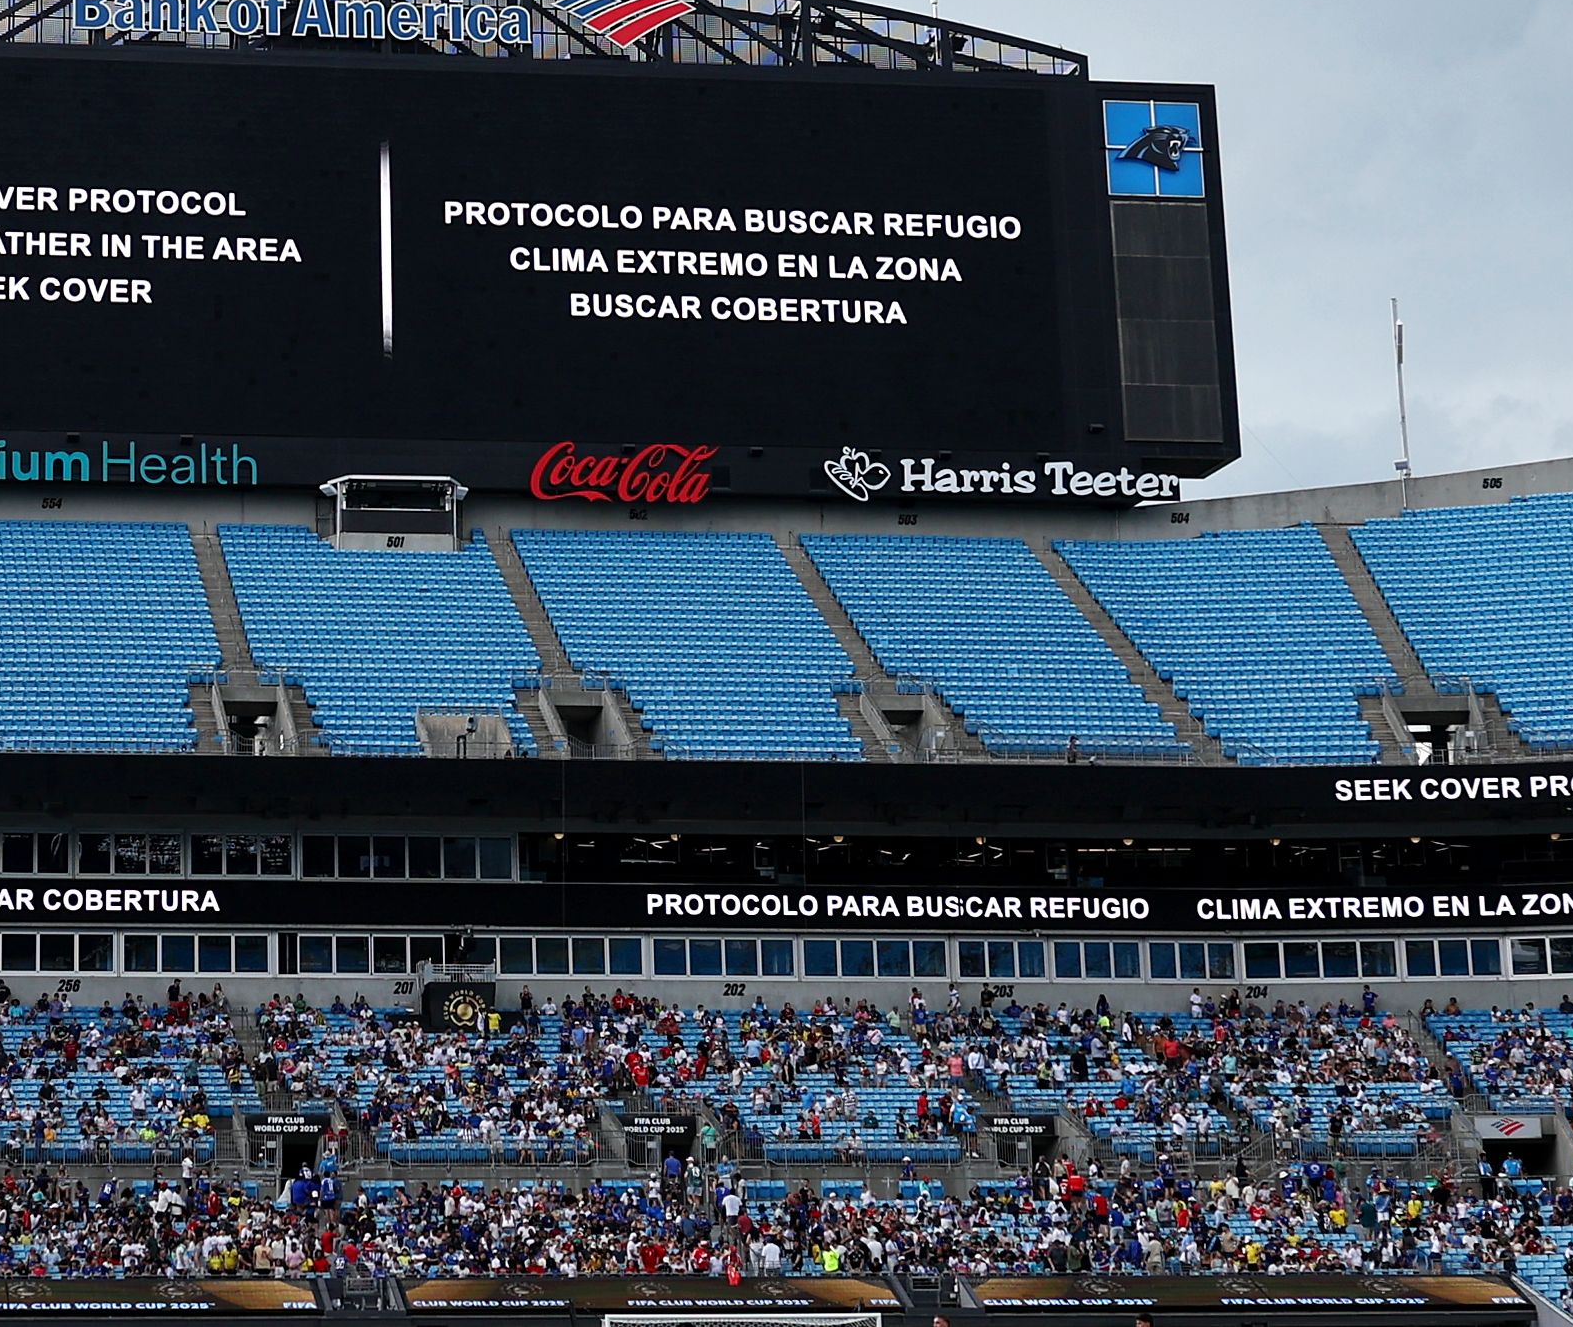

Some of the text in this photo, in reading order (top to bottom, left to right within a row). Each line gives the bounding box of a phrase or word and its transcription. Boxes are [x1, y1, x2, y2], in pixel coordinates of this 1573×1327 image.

[68, 187, 247, 216] PROTOCOL
[444, 200, 1022, 240] PROTOCOLO PARA BUSCAR REFUGIO
[101, 233, 131, 258] IN
[141, 234, 205, 260] THE
[212, 236, 302, 263] AREA
[509, 246, 963, 282] CLIMA EXTREMO EN LA ZONA
[39, 277, 153, 304] COVER
[570, 293, 908, 325] BUSCAR COBERTURA
[102, 441, 257, 484] Health
[530, 441, 719, 503] Coca-Cola
[900, 458, 1178, 497] Harris Teeter
[1482, 478, 1503, 490] 505
[41, 497, 62, 510] 554
[898, 514, 918, 526] 503
[1171, 513, 1190, 525] 504
[387, 536, 405, 549] 501
[1335, 778, 1413, 802] SEEK
[1420, 777, 1523, 800] COVER
[42, 888, 221, 912] COBERTURA
[646, 893, 1150, 920] PROTOCOLO PARA BUSCAR REFUGIO
[1196, 898, 1283, 920] CLIMA
[1288, 895, 1425, 920] EXTREMO
[1432, 895, 1470, 917] EN
[1478, 894, 1517, 917] LA
[57, 979, 81, 993] 256
[394, 981, 413, 995] 201
[723, 983, 746, 997] 202
[992, 985, 1015, 998] 203
[1246, 985, 1269, 999] 204
[267, 1116, 305, 1124] FIFA CLUB
[634, 1117, 671, 1125] FIFA CLUB
[1010, 1117, 1030, 1125] CLUB
[254, 1125, 282, 1133] WORLD
[283, 1125, 299, 1133] CUP
[650, 1126, 665, 1134] CUP
[31, 1302, 72, 1310] CLUB
[75, 1302, 132, 1310] WORLD
[136, 1302, 167, 1310] CUP
[983, 1298, 1023, 1306] CLUB
[1024, 1298, 1080, 1306] WORLD
[1082, 1298, 1112, 1306] CUP
[1221, 1297, 1256, 1305] FIFA
[1256, 1297, 1297, 1305] CLUB
[1298, 1297, 1352, 1305] WORLD
[1355, 1297, 1385, 1305] CUP
